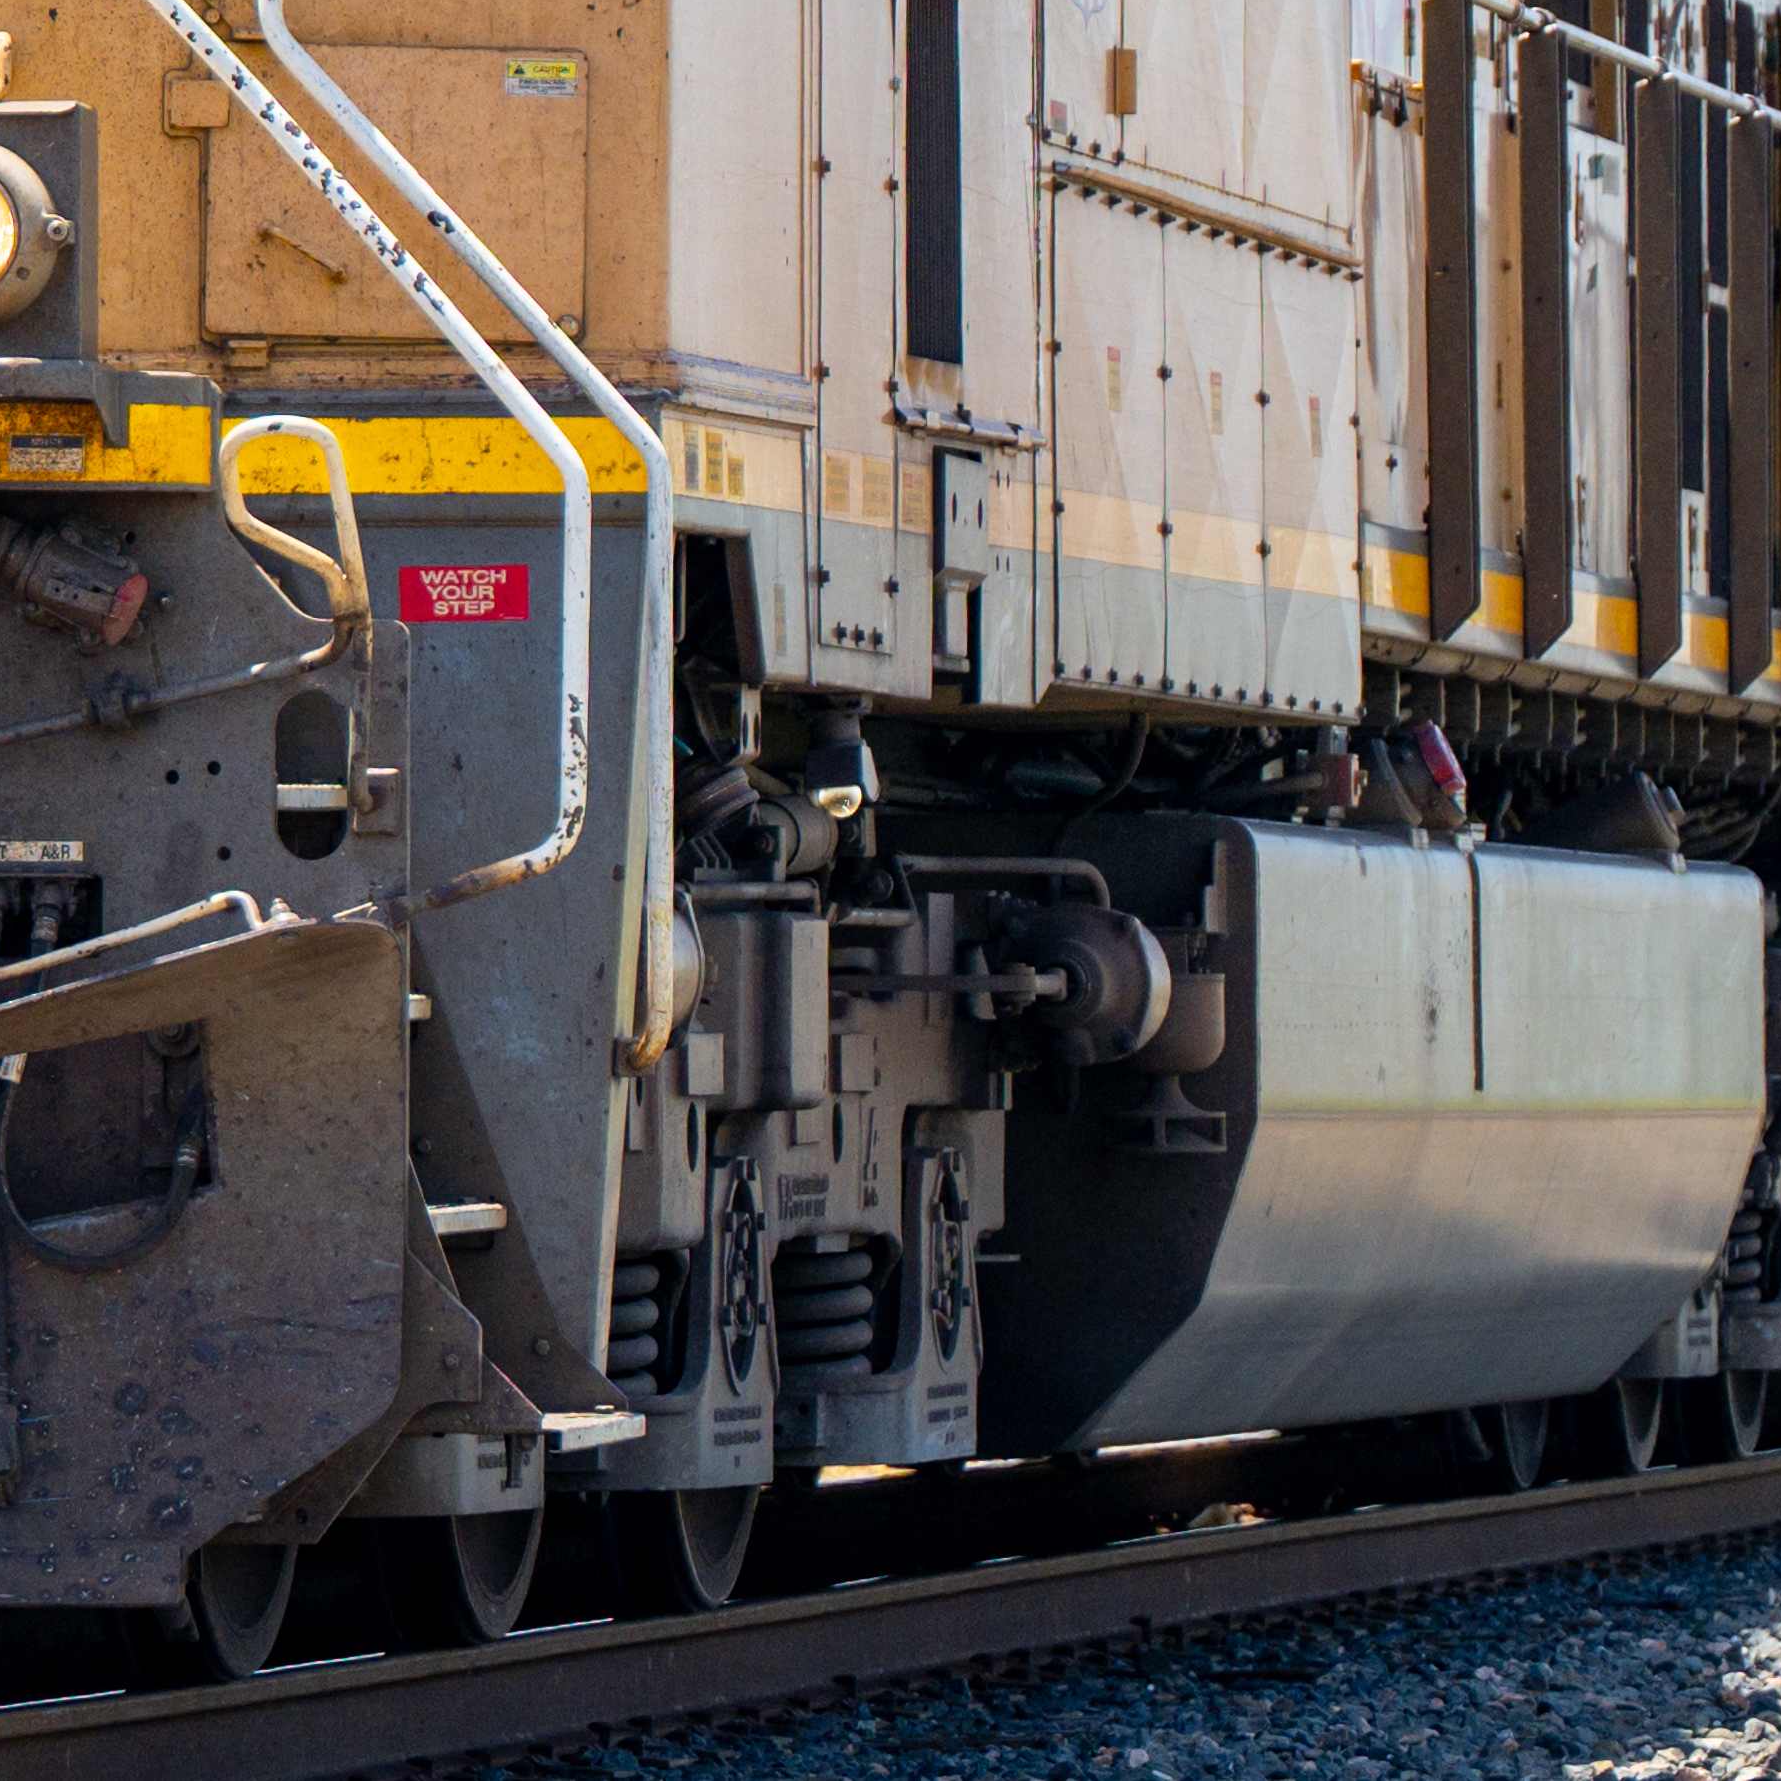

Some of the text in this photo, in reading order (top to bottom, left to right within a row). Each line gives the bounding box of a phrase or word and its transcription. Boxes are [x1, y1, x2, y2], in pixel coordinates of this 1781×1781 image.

[419, 569, 507, 585] WATCH
[426, 585, 495, 601] YOUR
[433, 600, 495, 616] STEP
[41, 844, 70, 859] A&R
